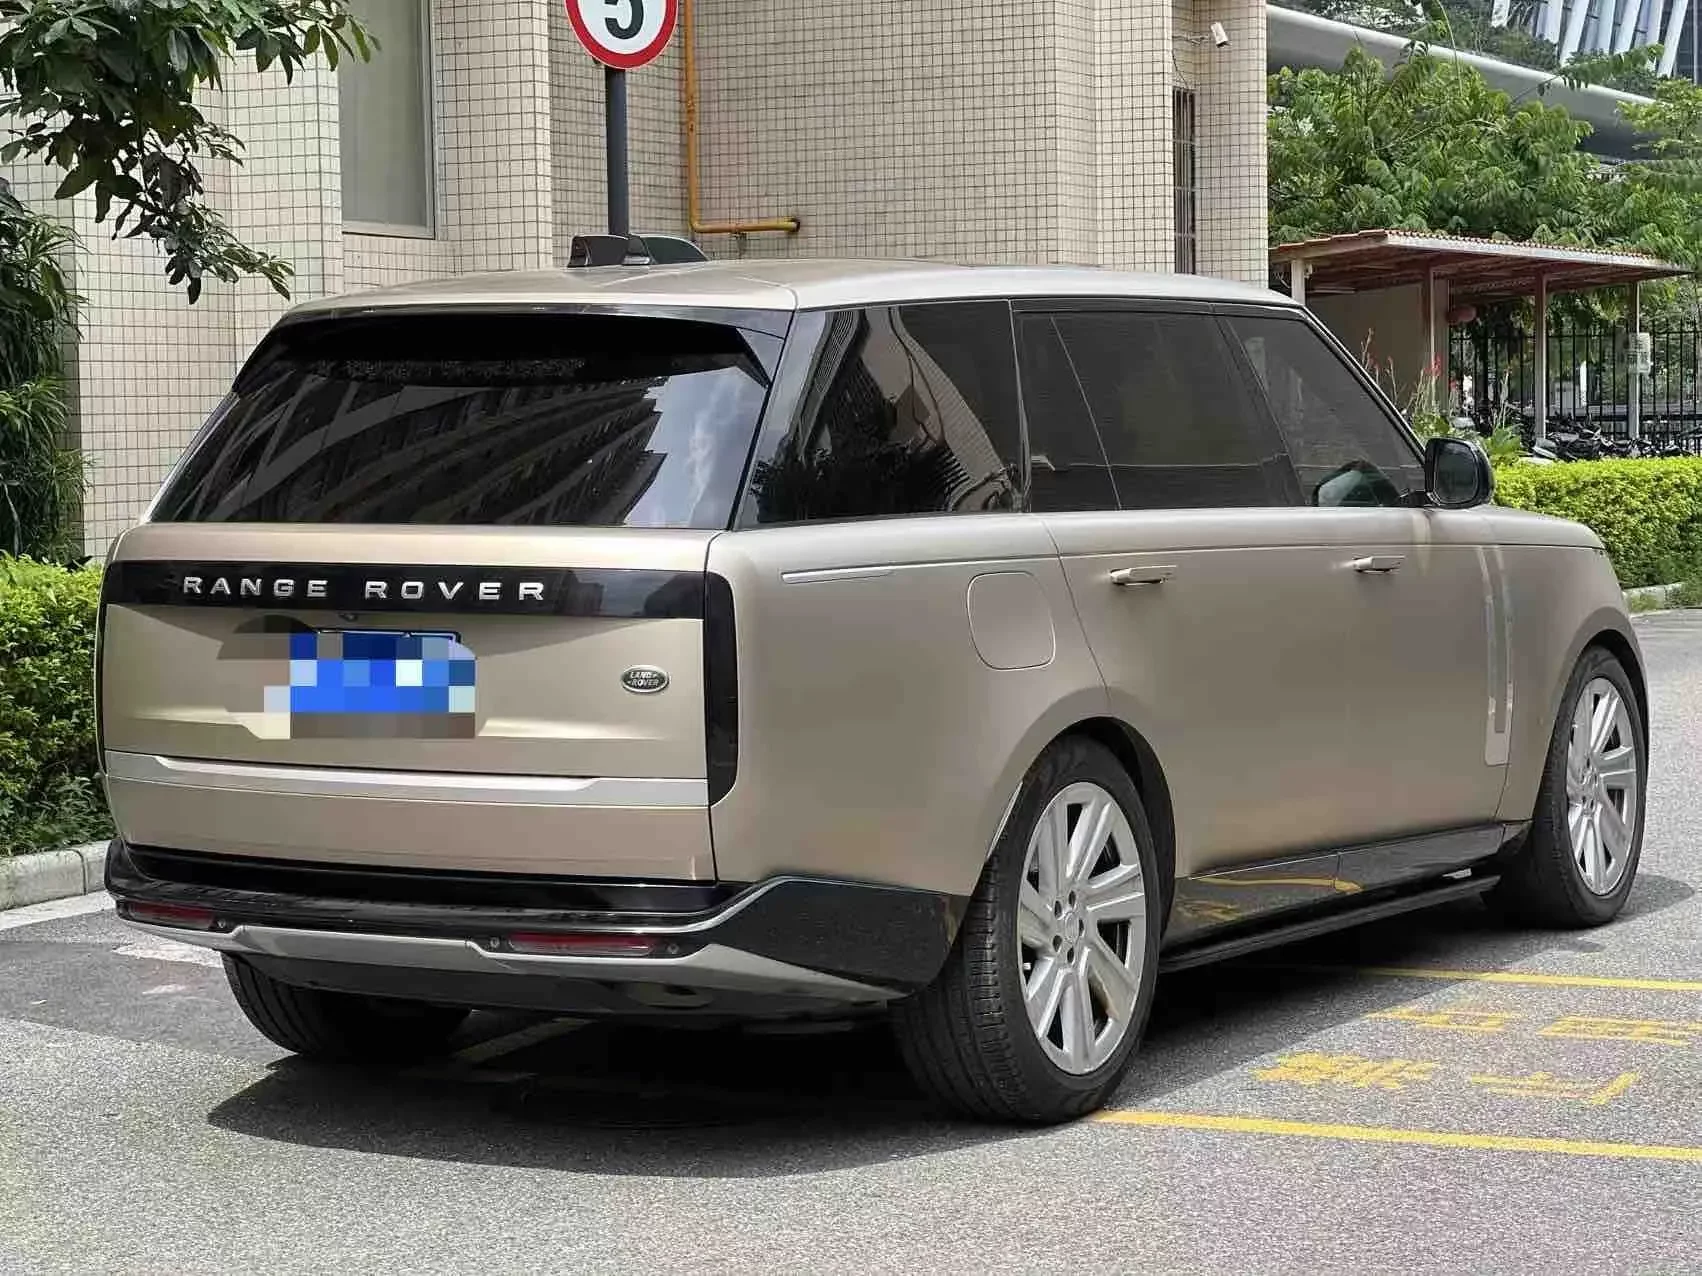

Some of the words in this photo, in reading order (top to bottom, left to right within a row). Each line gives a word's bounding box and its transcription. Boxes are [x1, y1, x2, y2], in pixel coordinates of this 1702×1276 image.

[605, 0, 644, 39] 5
[183, 576, 328, 598] RANGE
[365, 580, 544, 601] ROVER
